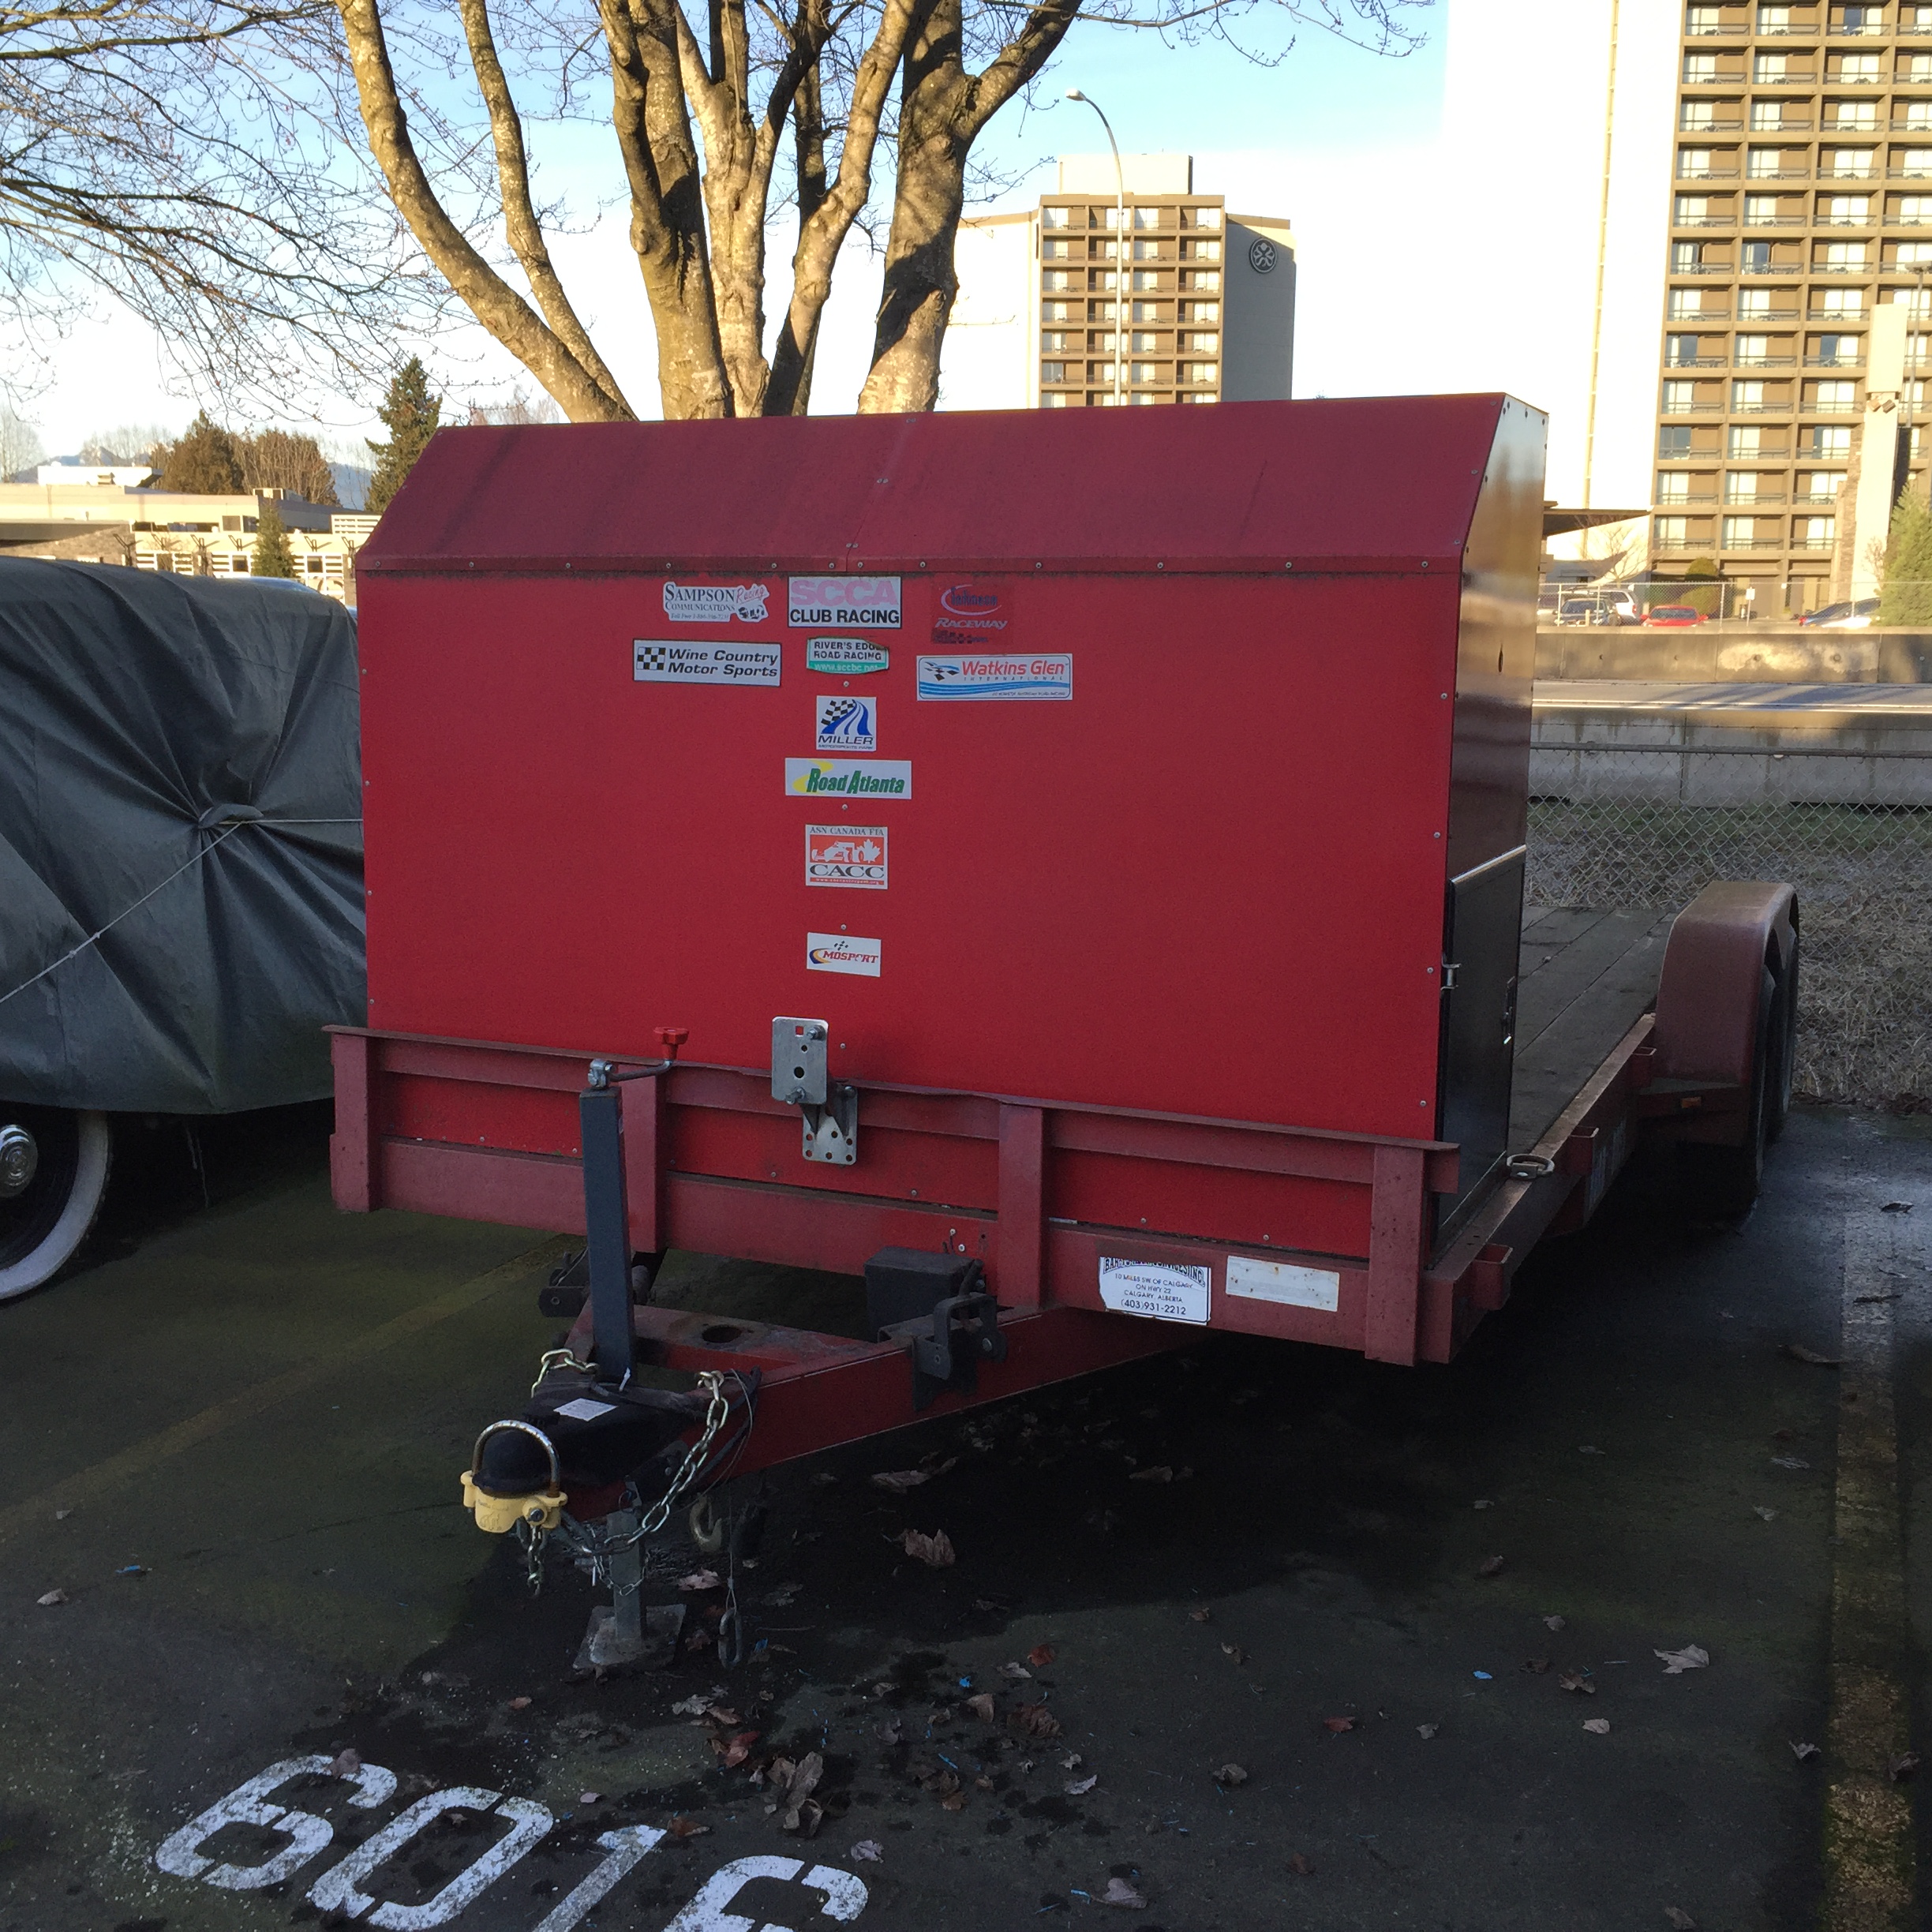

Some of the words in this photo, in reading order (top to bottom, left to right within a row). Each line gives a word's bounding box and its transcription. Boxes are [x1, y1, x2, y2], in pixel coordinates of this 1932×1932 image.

[665, 584, 736, 602] SAMPSON
[791, 580, 899, 606] SCCA
[790, 609, 832, 623] CLUB
[837, 609, 900, 623] RACING
[934, 617, 1008, 631] RACEWAY
[814, 641, 852, 650] RIVER'S
[669, 648, 708, 660] Wine
[713, 649, 778, 665] Country
[814, 650, 841, 659] ROAD
[844, 652, 882, 661] RACING
[668, 662, 718, 675] Motor
[723, 665, 777, 679] Sports
[961, 660, 1027, 676] Watkins
[1030, 660, 1065, 676] Glen
[818, 735, 874, 745] MILLER
[806, 768, 848, 792] Road
[846, 770, 905, 794] Atlanta
[829, 826, 867, 835] CANADA
[810, 864, 884, 878] CACC
[1163, 1279, 1193, 1289] CALGARY
[1157, 1294, 1183, 1303] ALBERTA
[1121, 1298, 1186, 1315] (403)931-2212
